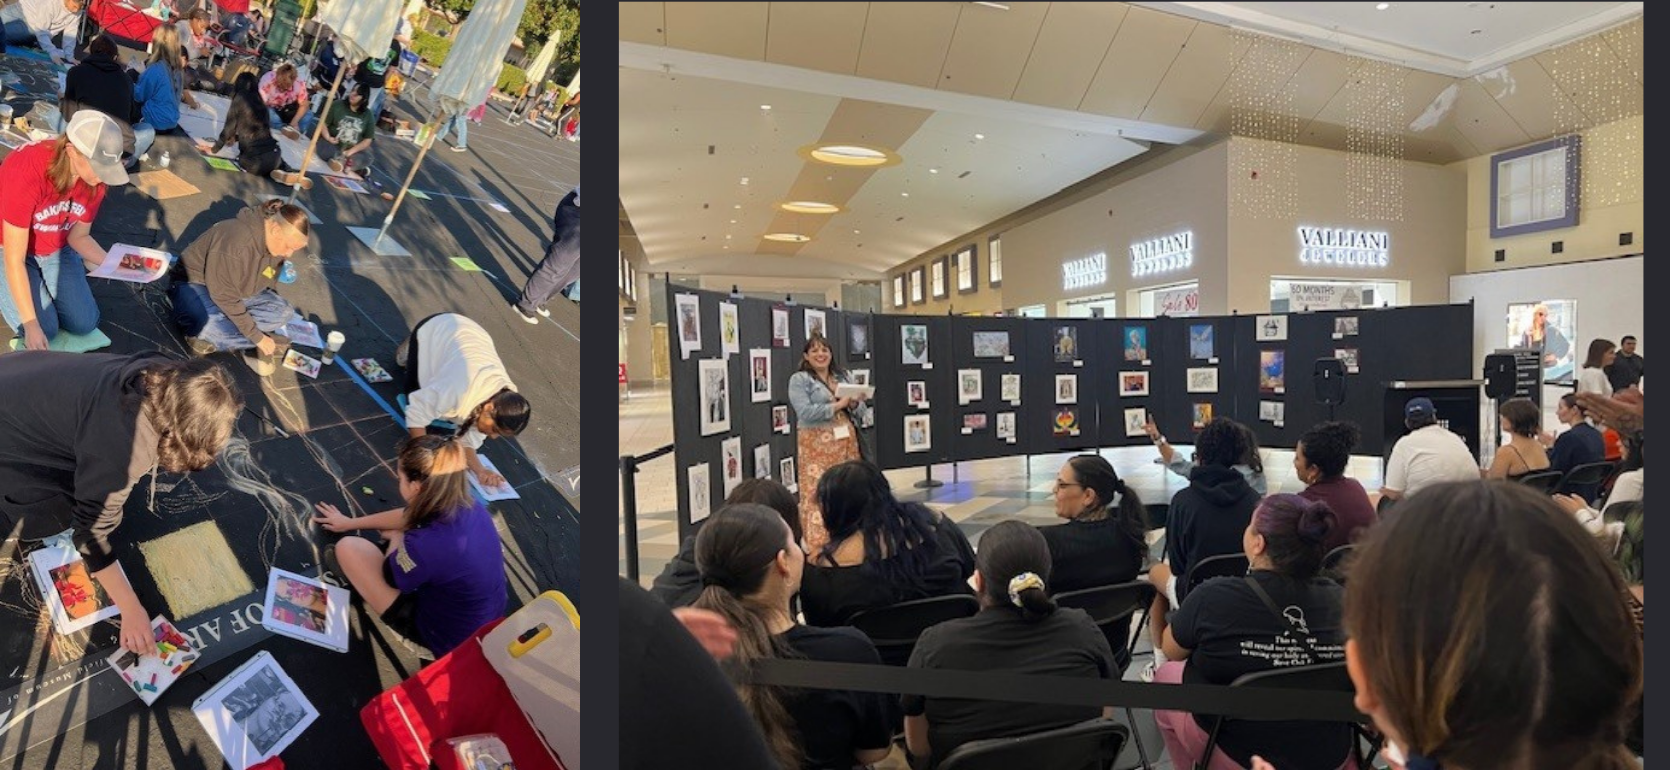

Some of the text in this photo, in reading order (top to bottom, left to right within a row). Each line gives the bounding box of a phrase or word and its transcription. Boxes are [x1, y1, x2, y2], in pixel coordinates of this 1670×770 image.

[1130, 230, 1193, 262] VALLIANI
[1298, 227, 1389, 250] VALLIANI
[1062, 252, 1106, 278] VALLIANI
[1303, 285, 1335, 295] MONTHS
[1162, 291, 1199, 313] Sale 80
[185, 602, 264, 651] OF AR
[26, 671, 72, 695] Museum
[7, 693, 19, 705] of
